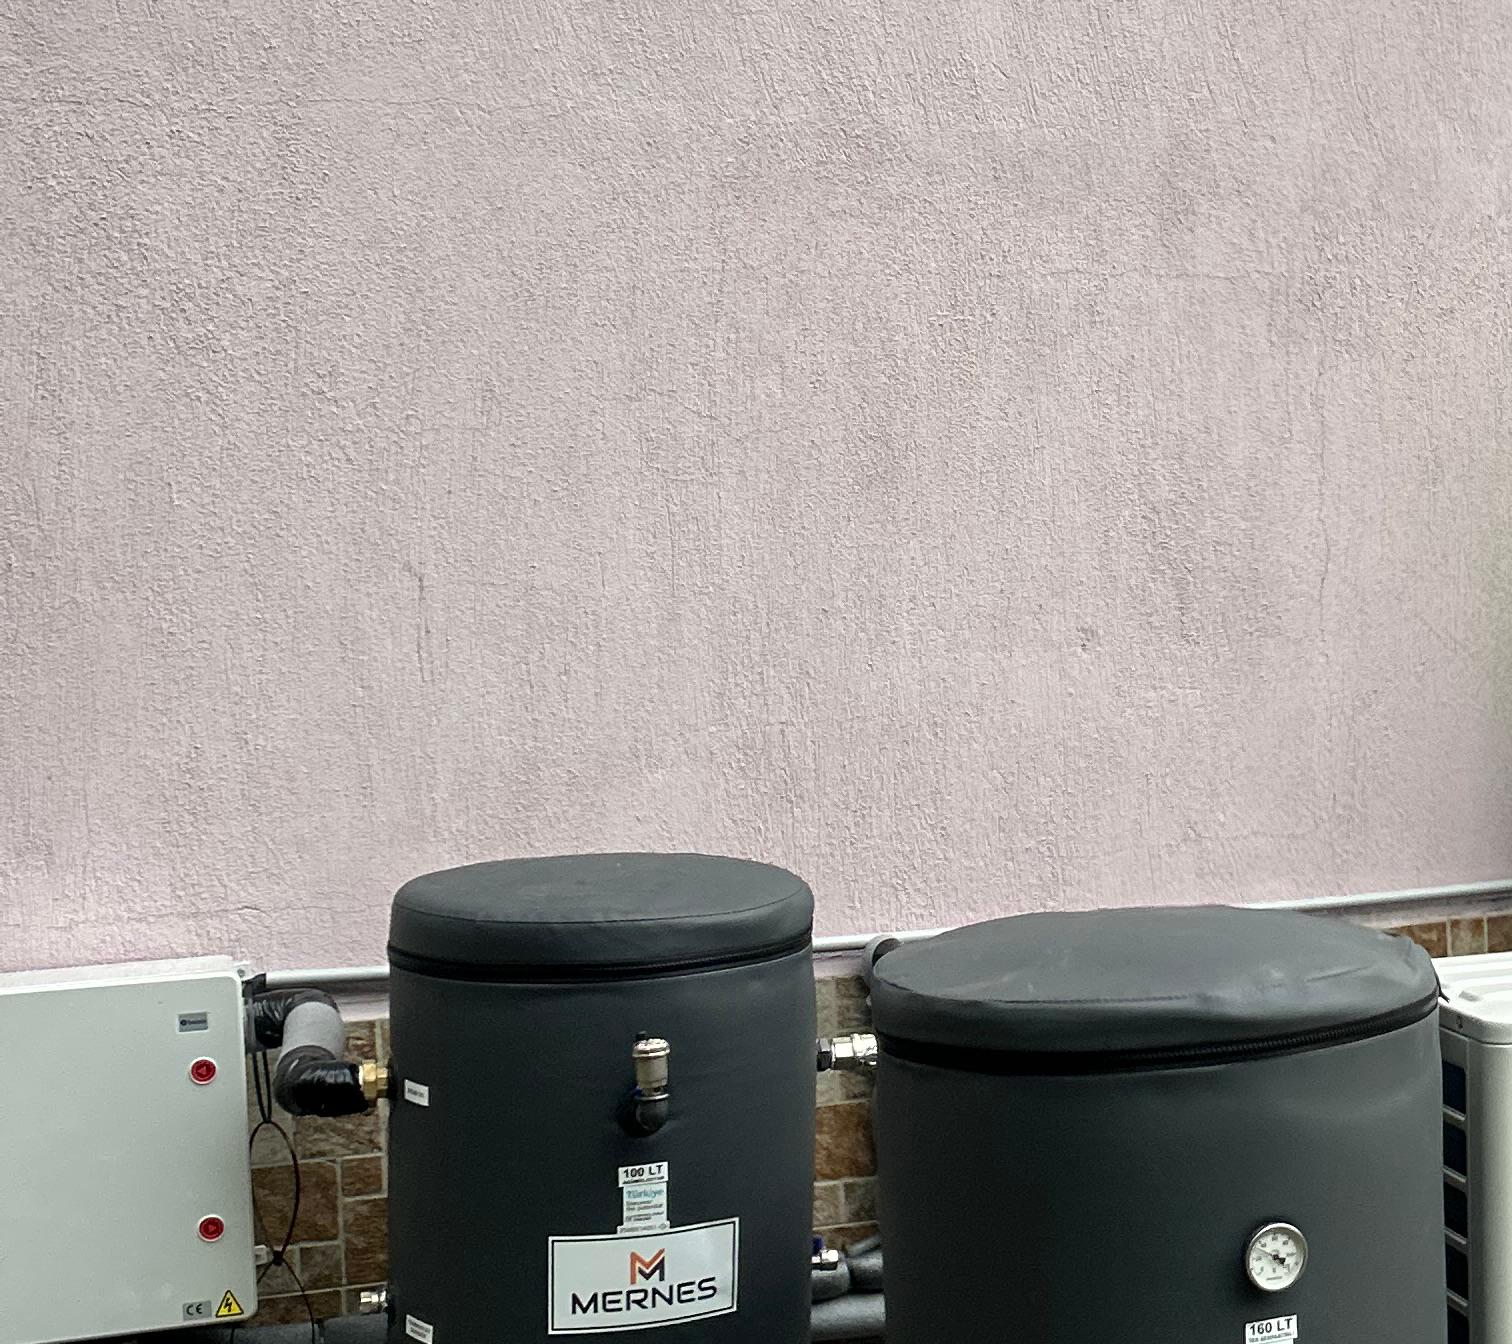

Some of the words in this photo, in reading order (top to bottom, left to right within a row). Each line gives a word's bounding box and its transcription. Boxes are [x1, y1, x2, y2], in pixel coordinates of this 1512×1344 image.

[623, 1167, 645, 1178] 100
[648, 1164, 663, 1175] LT
[571, 1276, 718, 1315] MERNES
[186, 1303, 203, 1316] CE
[1249, 1321, 1272, 1336] 160
[1276, 1317, 1293, 1332] LT
